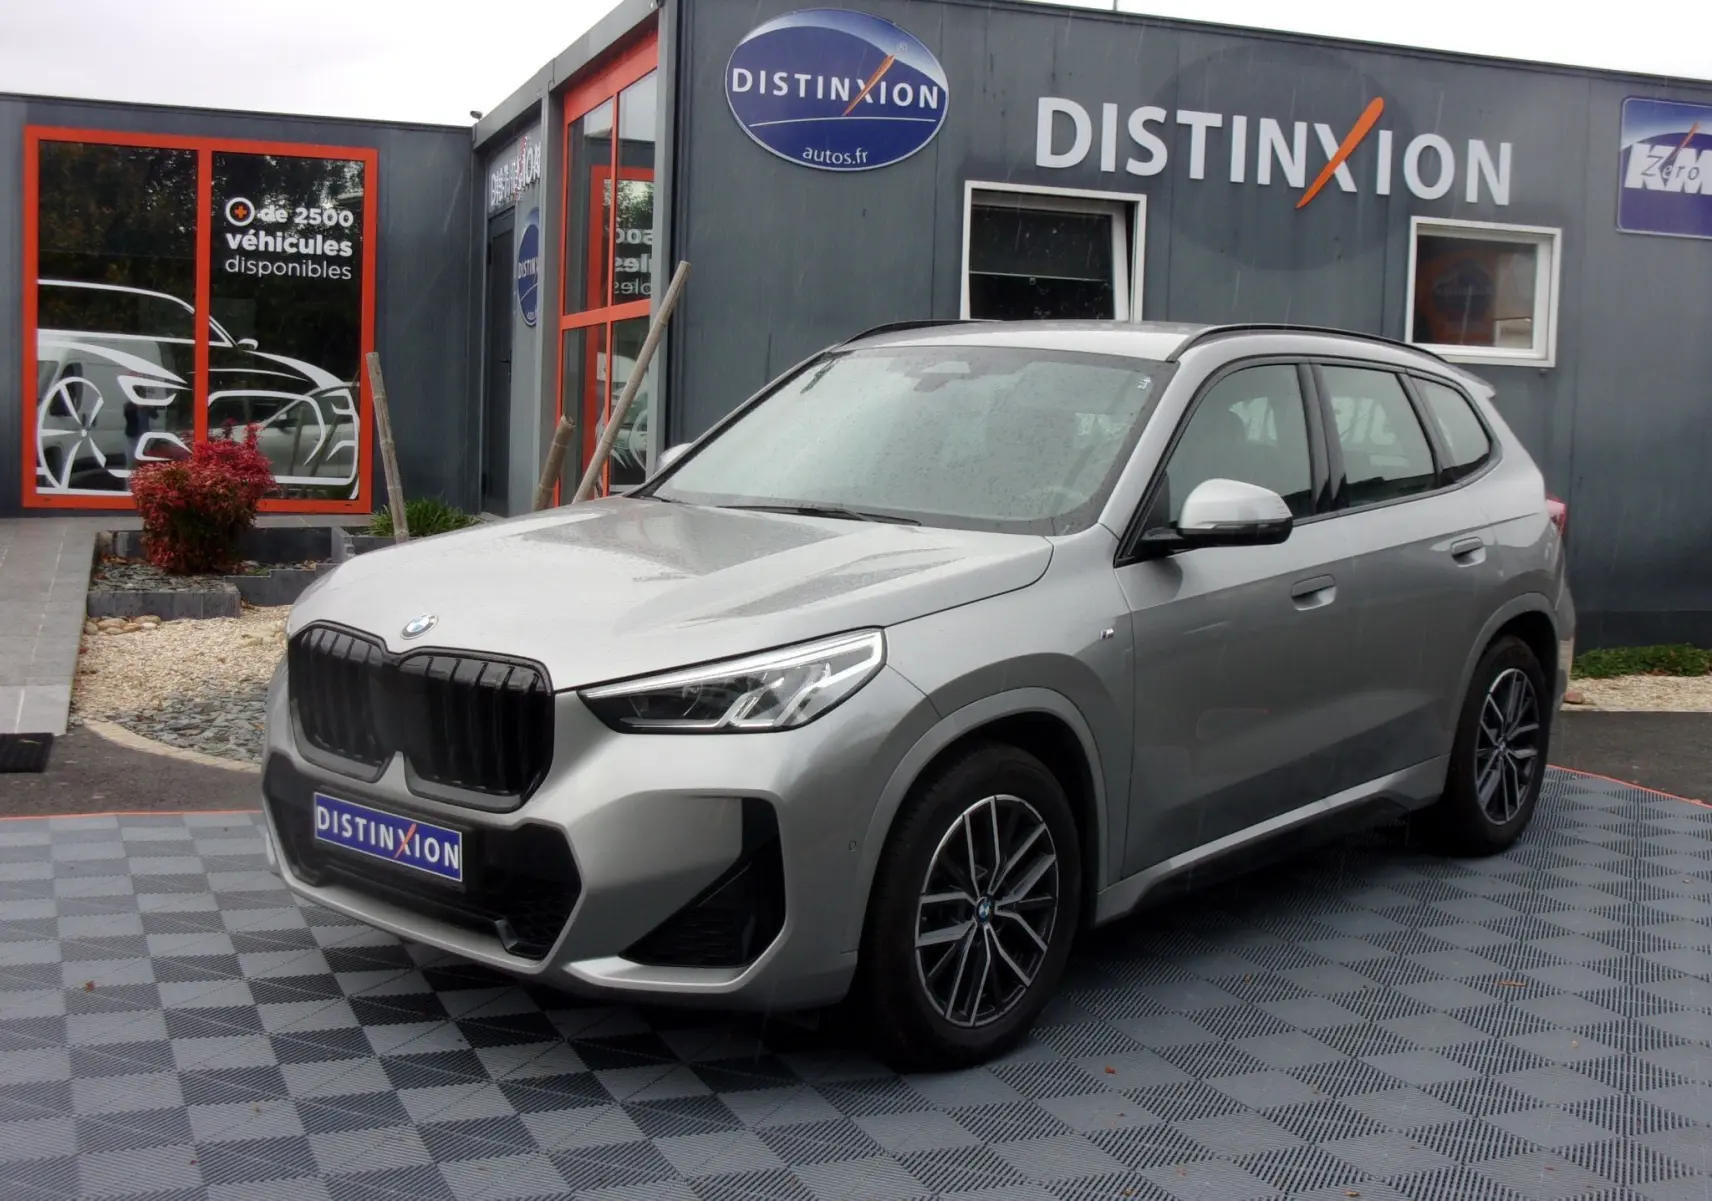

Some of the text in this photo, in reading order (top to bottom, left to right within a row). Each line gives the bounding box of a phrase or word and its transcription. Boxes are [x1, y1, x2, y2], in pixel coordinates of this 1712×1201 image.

[732, 55, 938, 117] DISTINXION
[802, 146, 869, 165] autos.fr
[1036, 97, 1512, 207] DISTINXION
[1624, 142, 1712, 195] KM
[259, 205, 288, 223] de
[294, 207, 354, 227] 2500
[226, 229, 353, 257] véhicules
[225, 255, 352, 280] disponibles
[317, 805, 459, 869] DISTINXION
